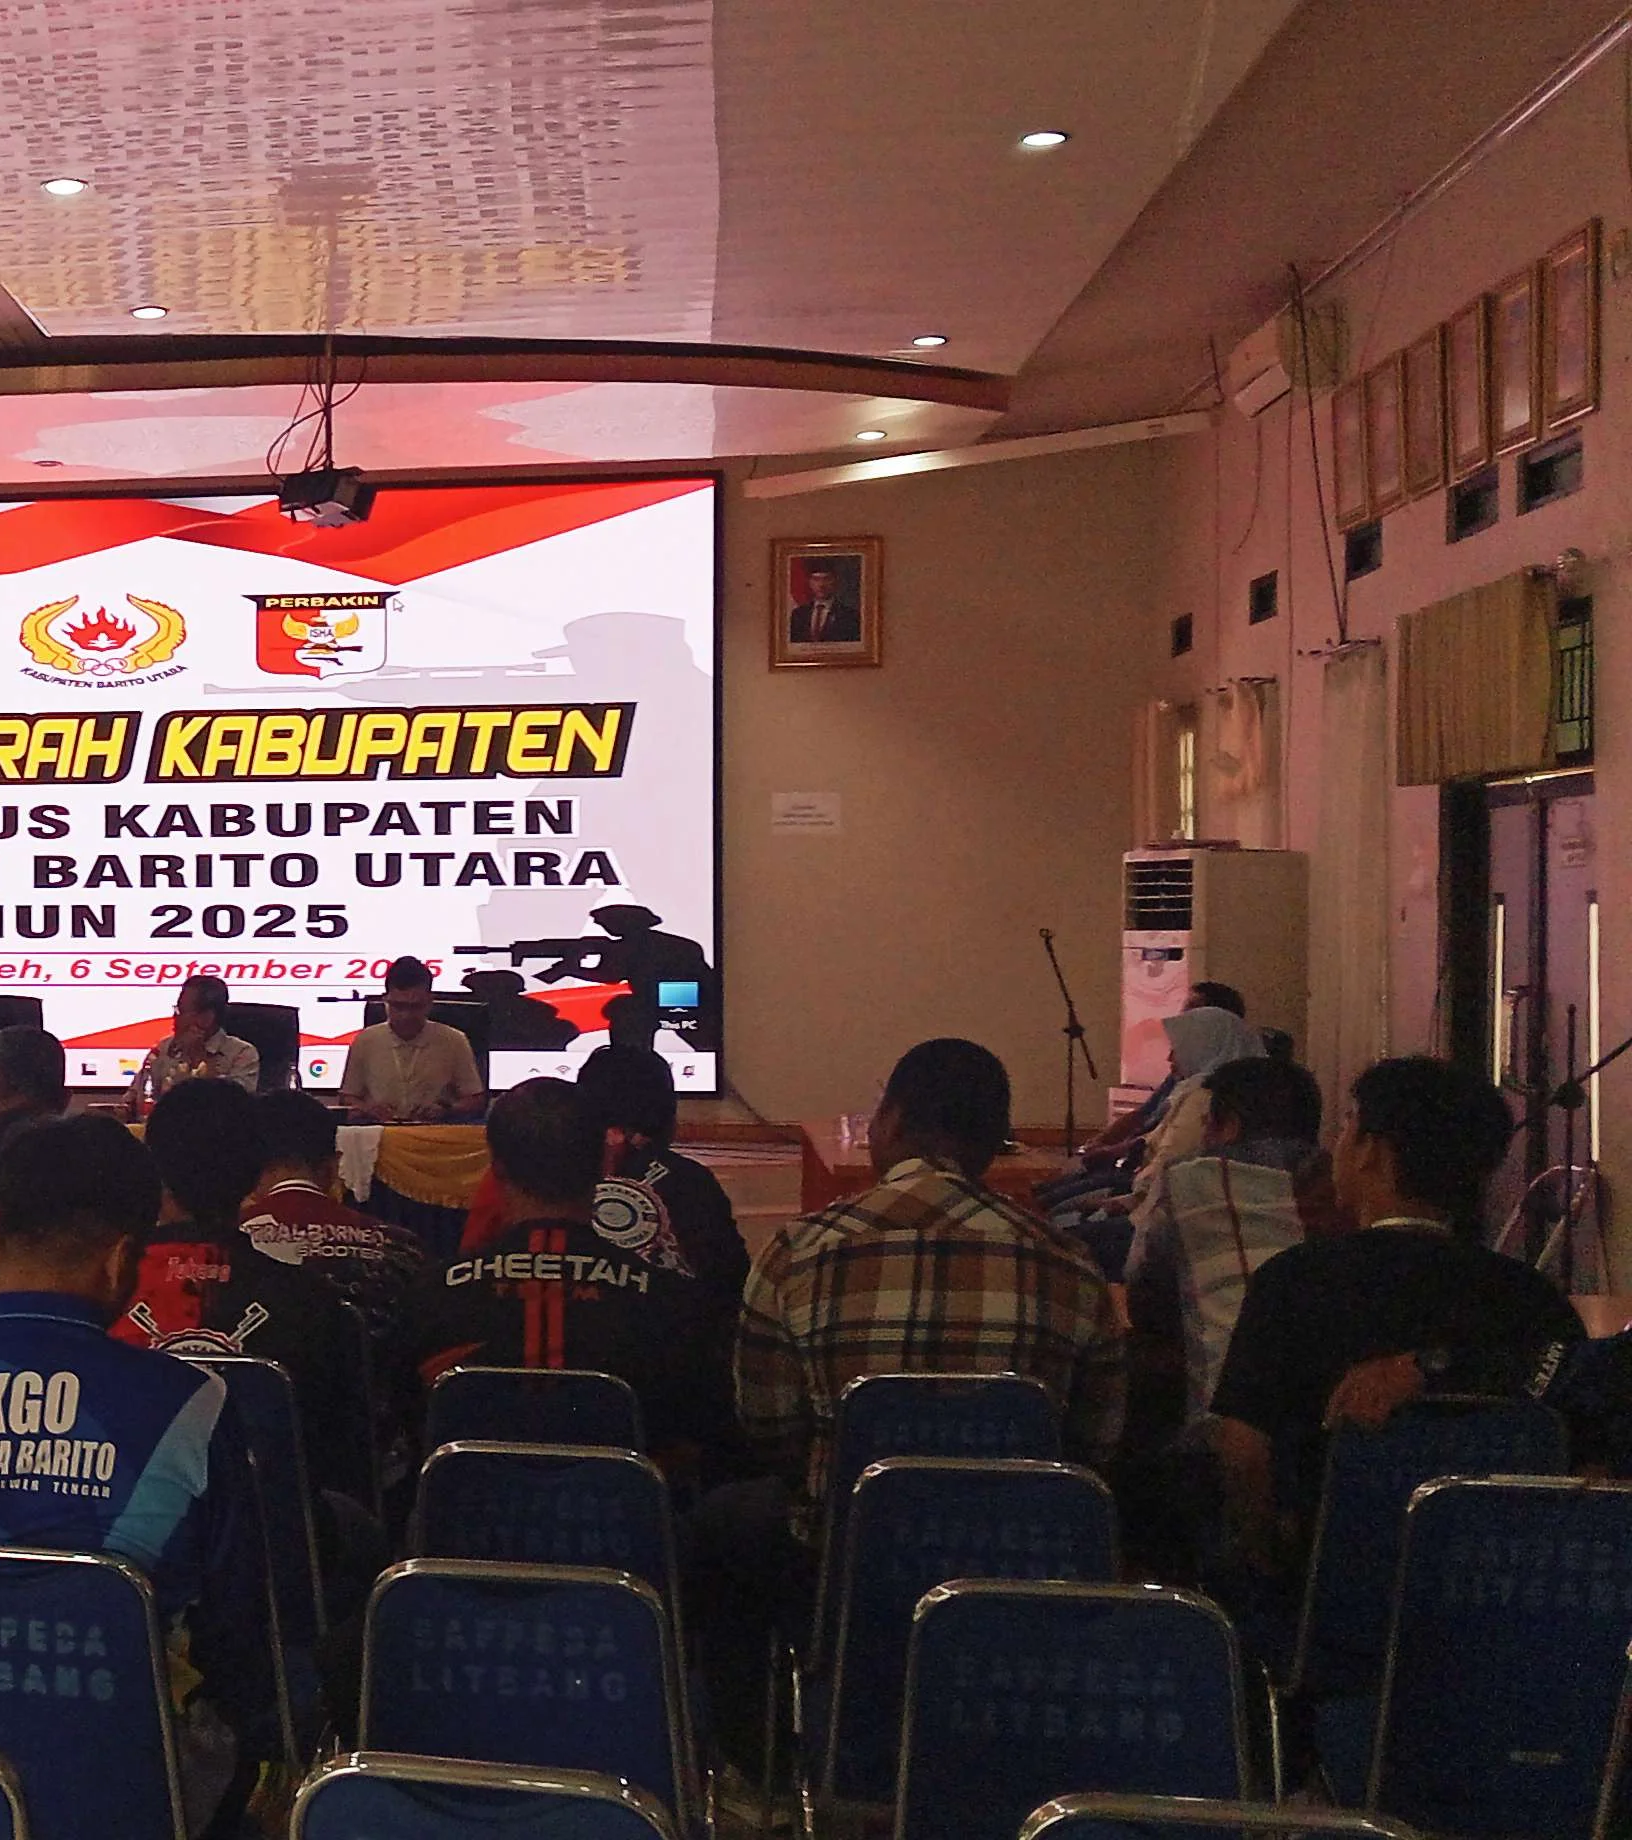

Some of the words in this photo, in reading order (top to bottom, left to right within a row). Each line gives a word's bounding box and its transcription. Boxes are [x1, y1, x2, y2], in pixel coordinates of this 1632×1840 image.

[265, 595, 380, 608] PERBAKIN
[20, 667, 93, 688] KABUPATEN
[96, 677, 145, 689] BARITO
[146, 664, 189, 683] UTARA
[157, 707, 624, 778] KABUPATEN
[103, 799, 574, 838] KABUPATEN
[33, 853, 320, 889] BARITO
[354, 850, 623, 887] UTARA
[149, 902, 350, 939] 2025
[70, 958, 91, 979] 6
[104, 957, 334, 984] September
[344, 958, 444, 980] 205
[681, 1019, 699, 1031] PC
[444, 1252, 650, 1296] CHEETAH
[15, 1439, 118, 1482] BARITO
